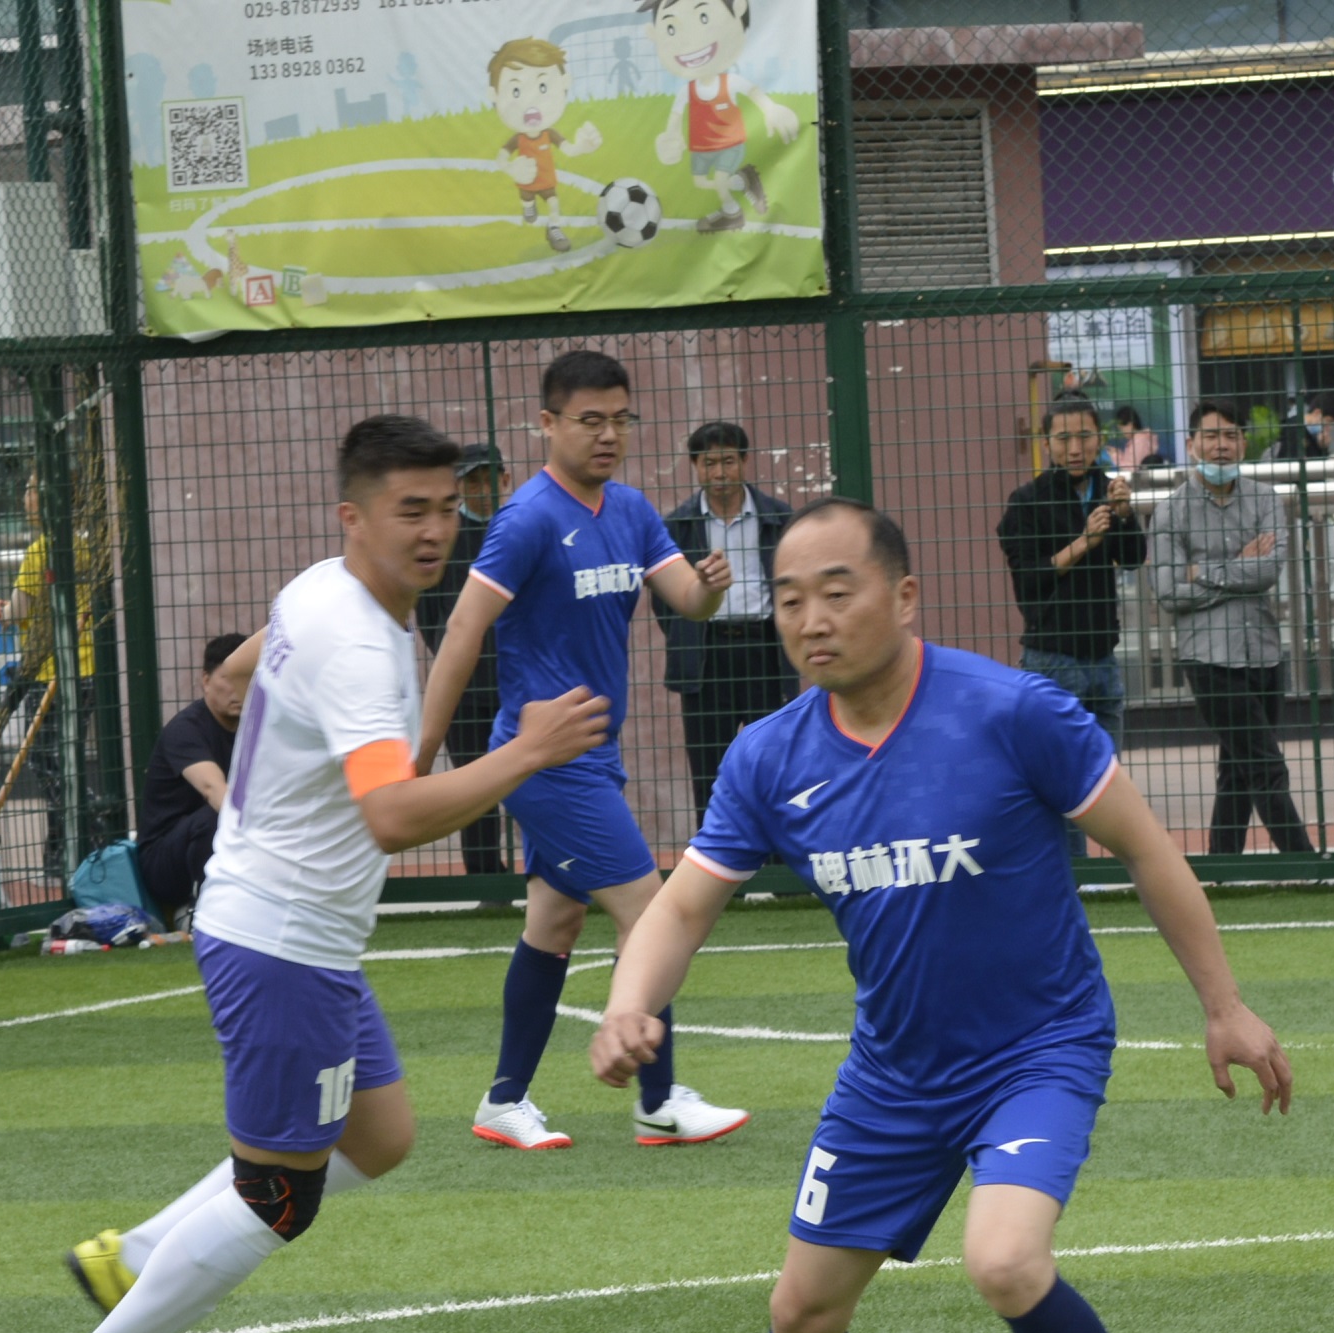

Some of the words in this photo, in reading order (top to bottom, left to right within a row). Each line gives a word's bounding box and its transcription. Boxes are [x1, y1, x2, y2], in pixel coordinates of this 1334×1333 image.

[247, 35, 315, 57] 场地电话
[250, 64, 278, 81] 133
[281, 61, 322, 78] 8928
[325, 57, 365, 75] 0362
[795, 1145, 838, 1226] 6
